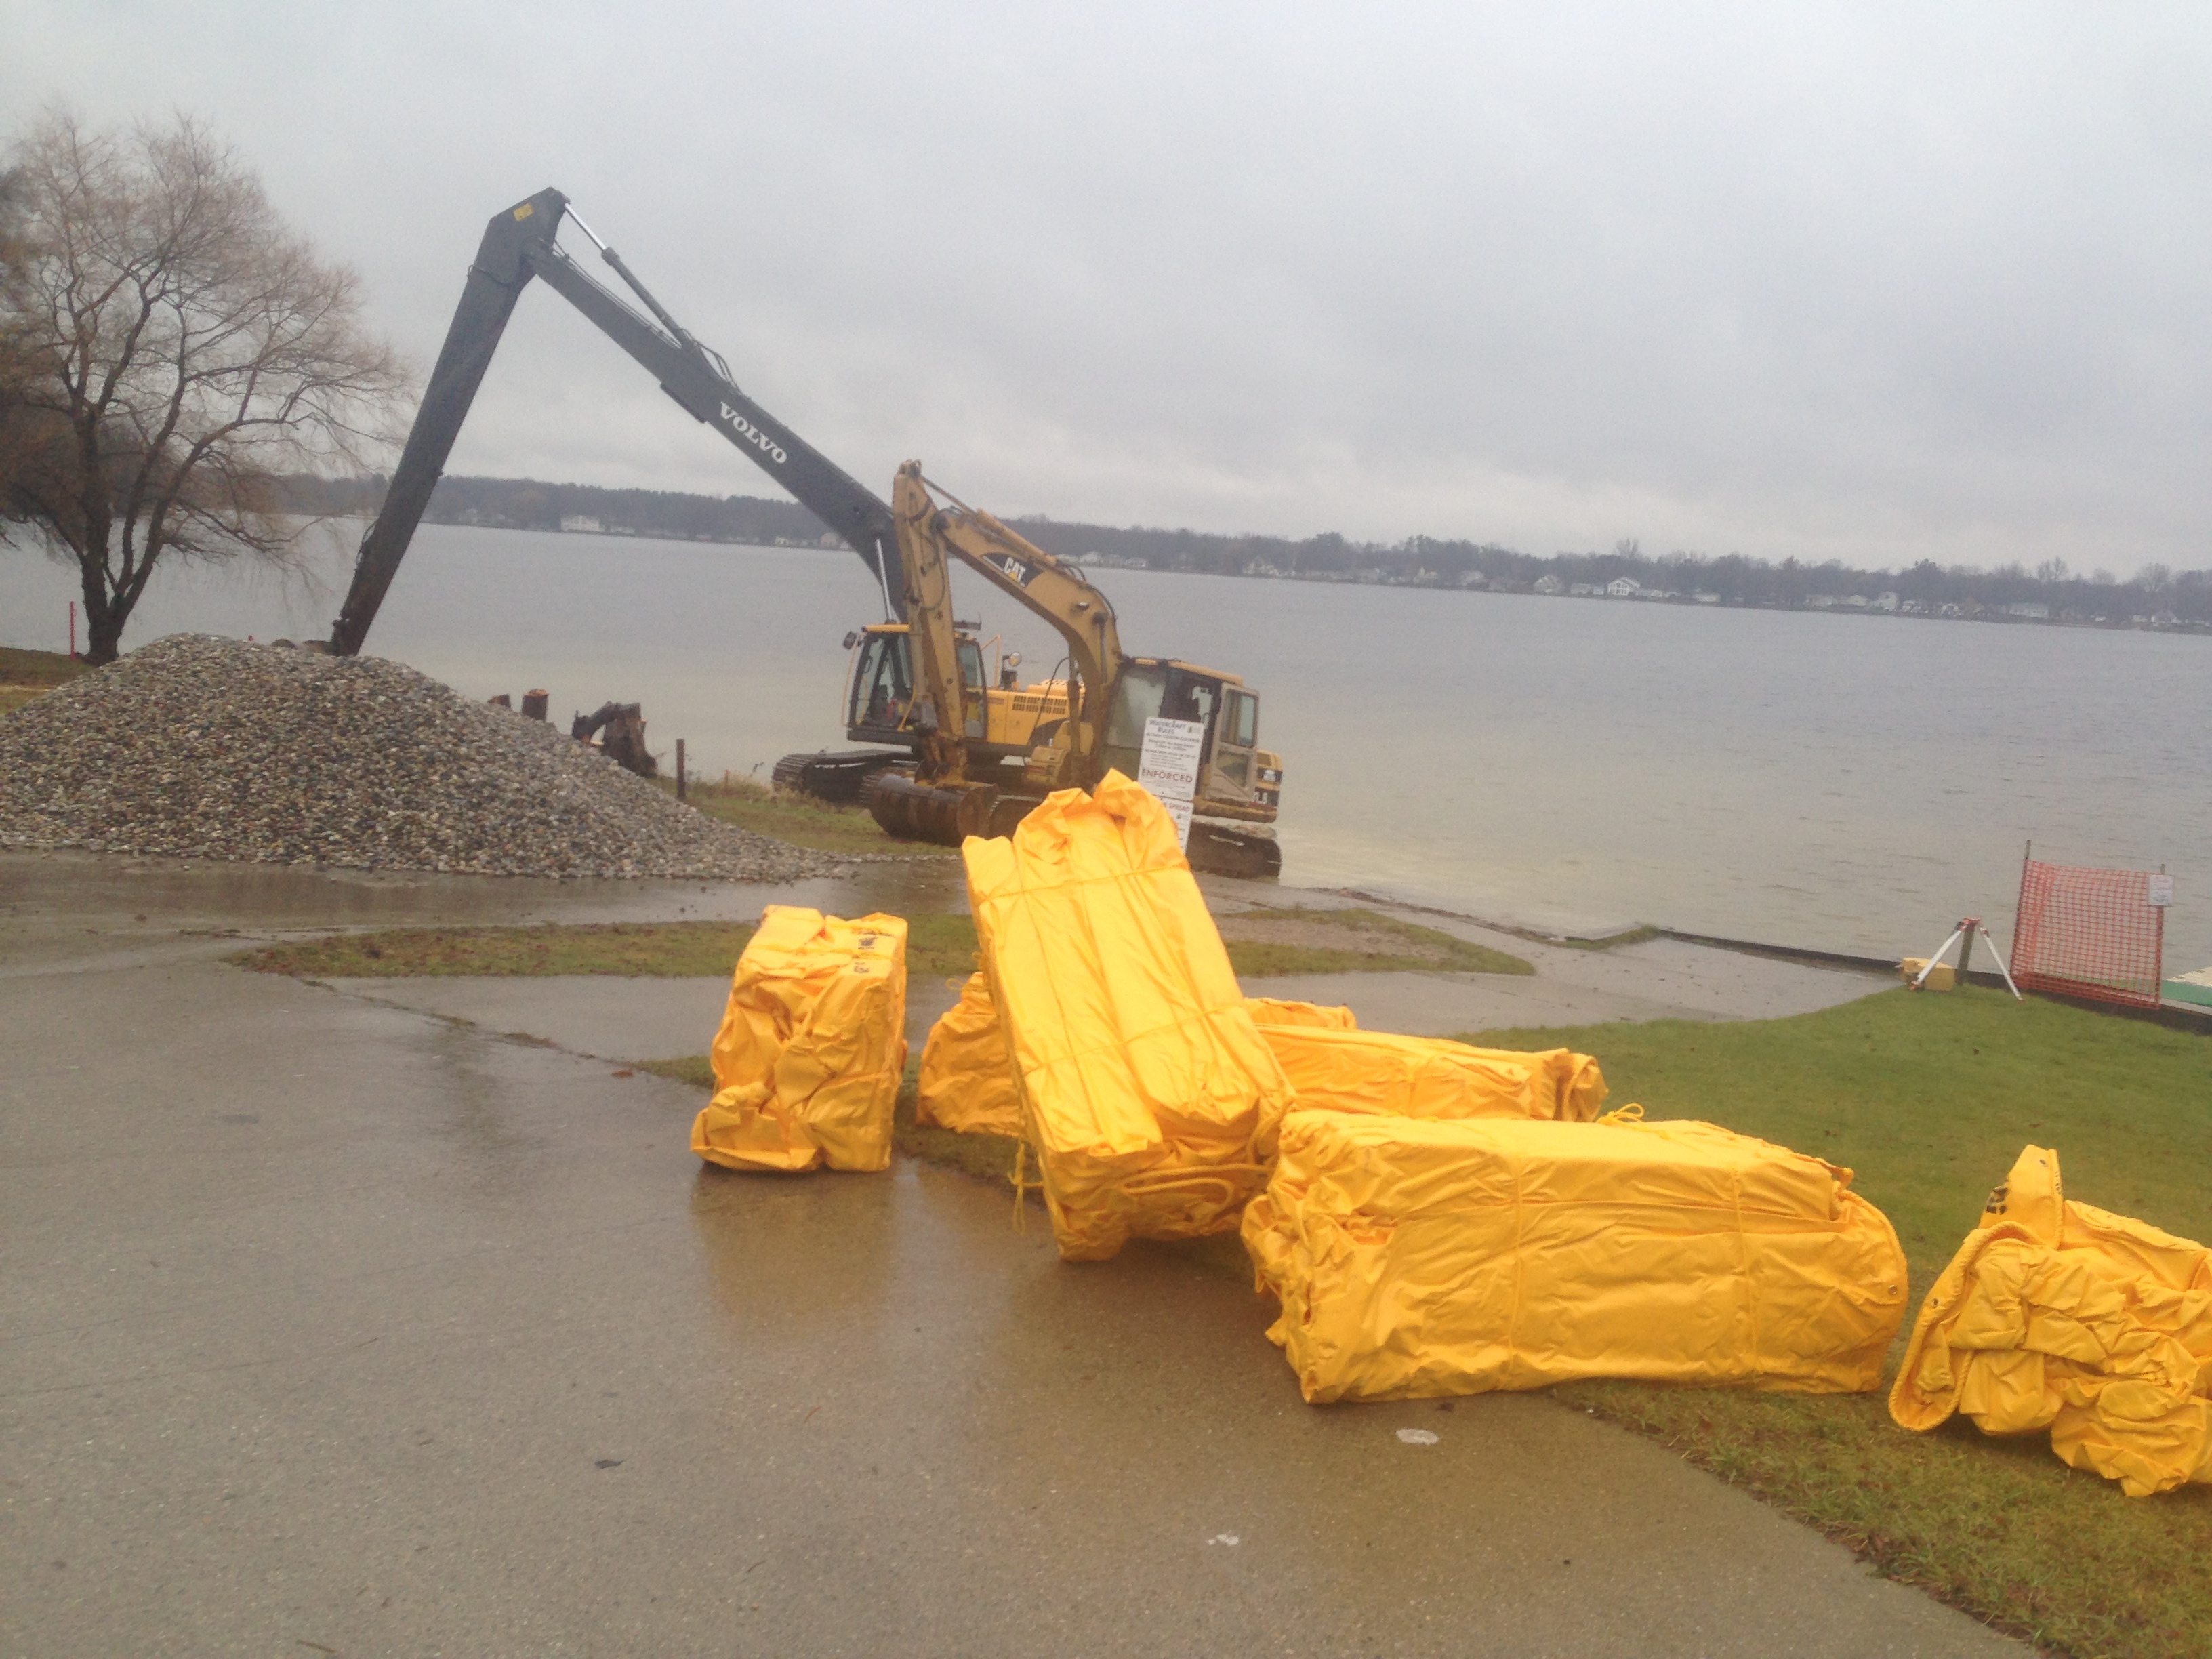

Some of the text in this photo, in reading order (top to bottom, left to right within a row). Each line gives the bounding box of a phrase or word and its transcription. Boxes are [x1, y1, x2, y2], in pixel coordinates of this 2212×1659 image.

[720, 401, 787, 464] VOLVO
[1004, 556, 1026, 583] CAT
[1142, 769, 1193, 783] ENFORCED
